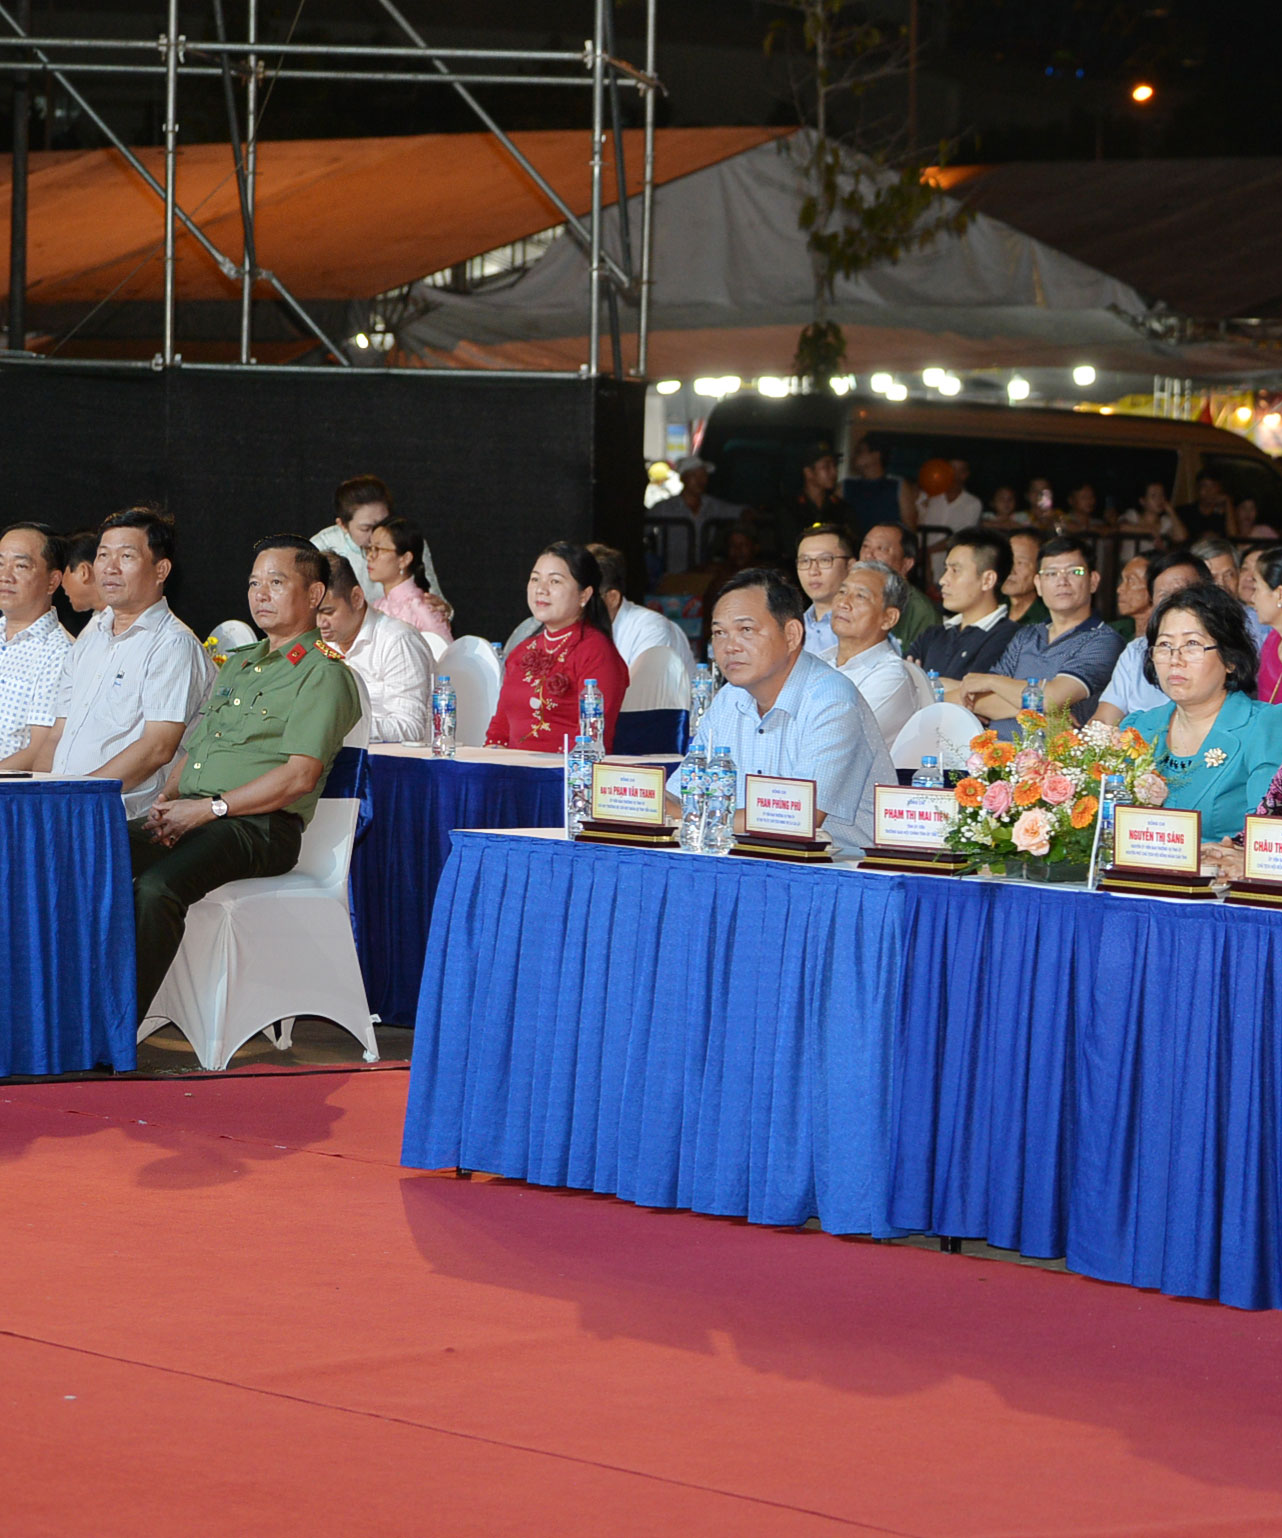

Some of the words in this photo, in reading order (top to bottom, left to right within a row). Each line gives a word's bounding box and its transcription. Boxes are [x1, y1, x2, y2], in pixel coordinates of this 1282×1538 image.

[884, 809, 904, 821] PHẠM
[906, 810, 916, 822] THỊ
[918, 811, 931, 821] MAI
[1129, 828, 1154, 841] NGUYỄN
[1156, 832, 1165, 844] THỊ
[1167, 831, 1184, 844] SÁNG
[1254, 839, 1272, 852] CHÂU
